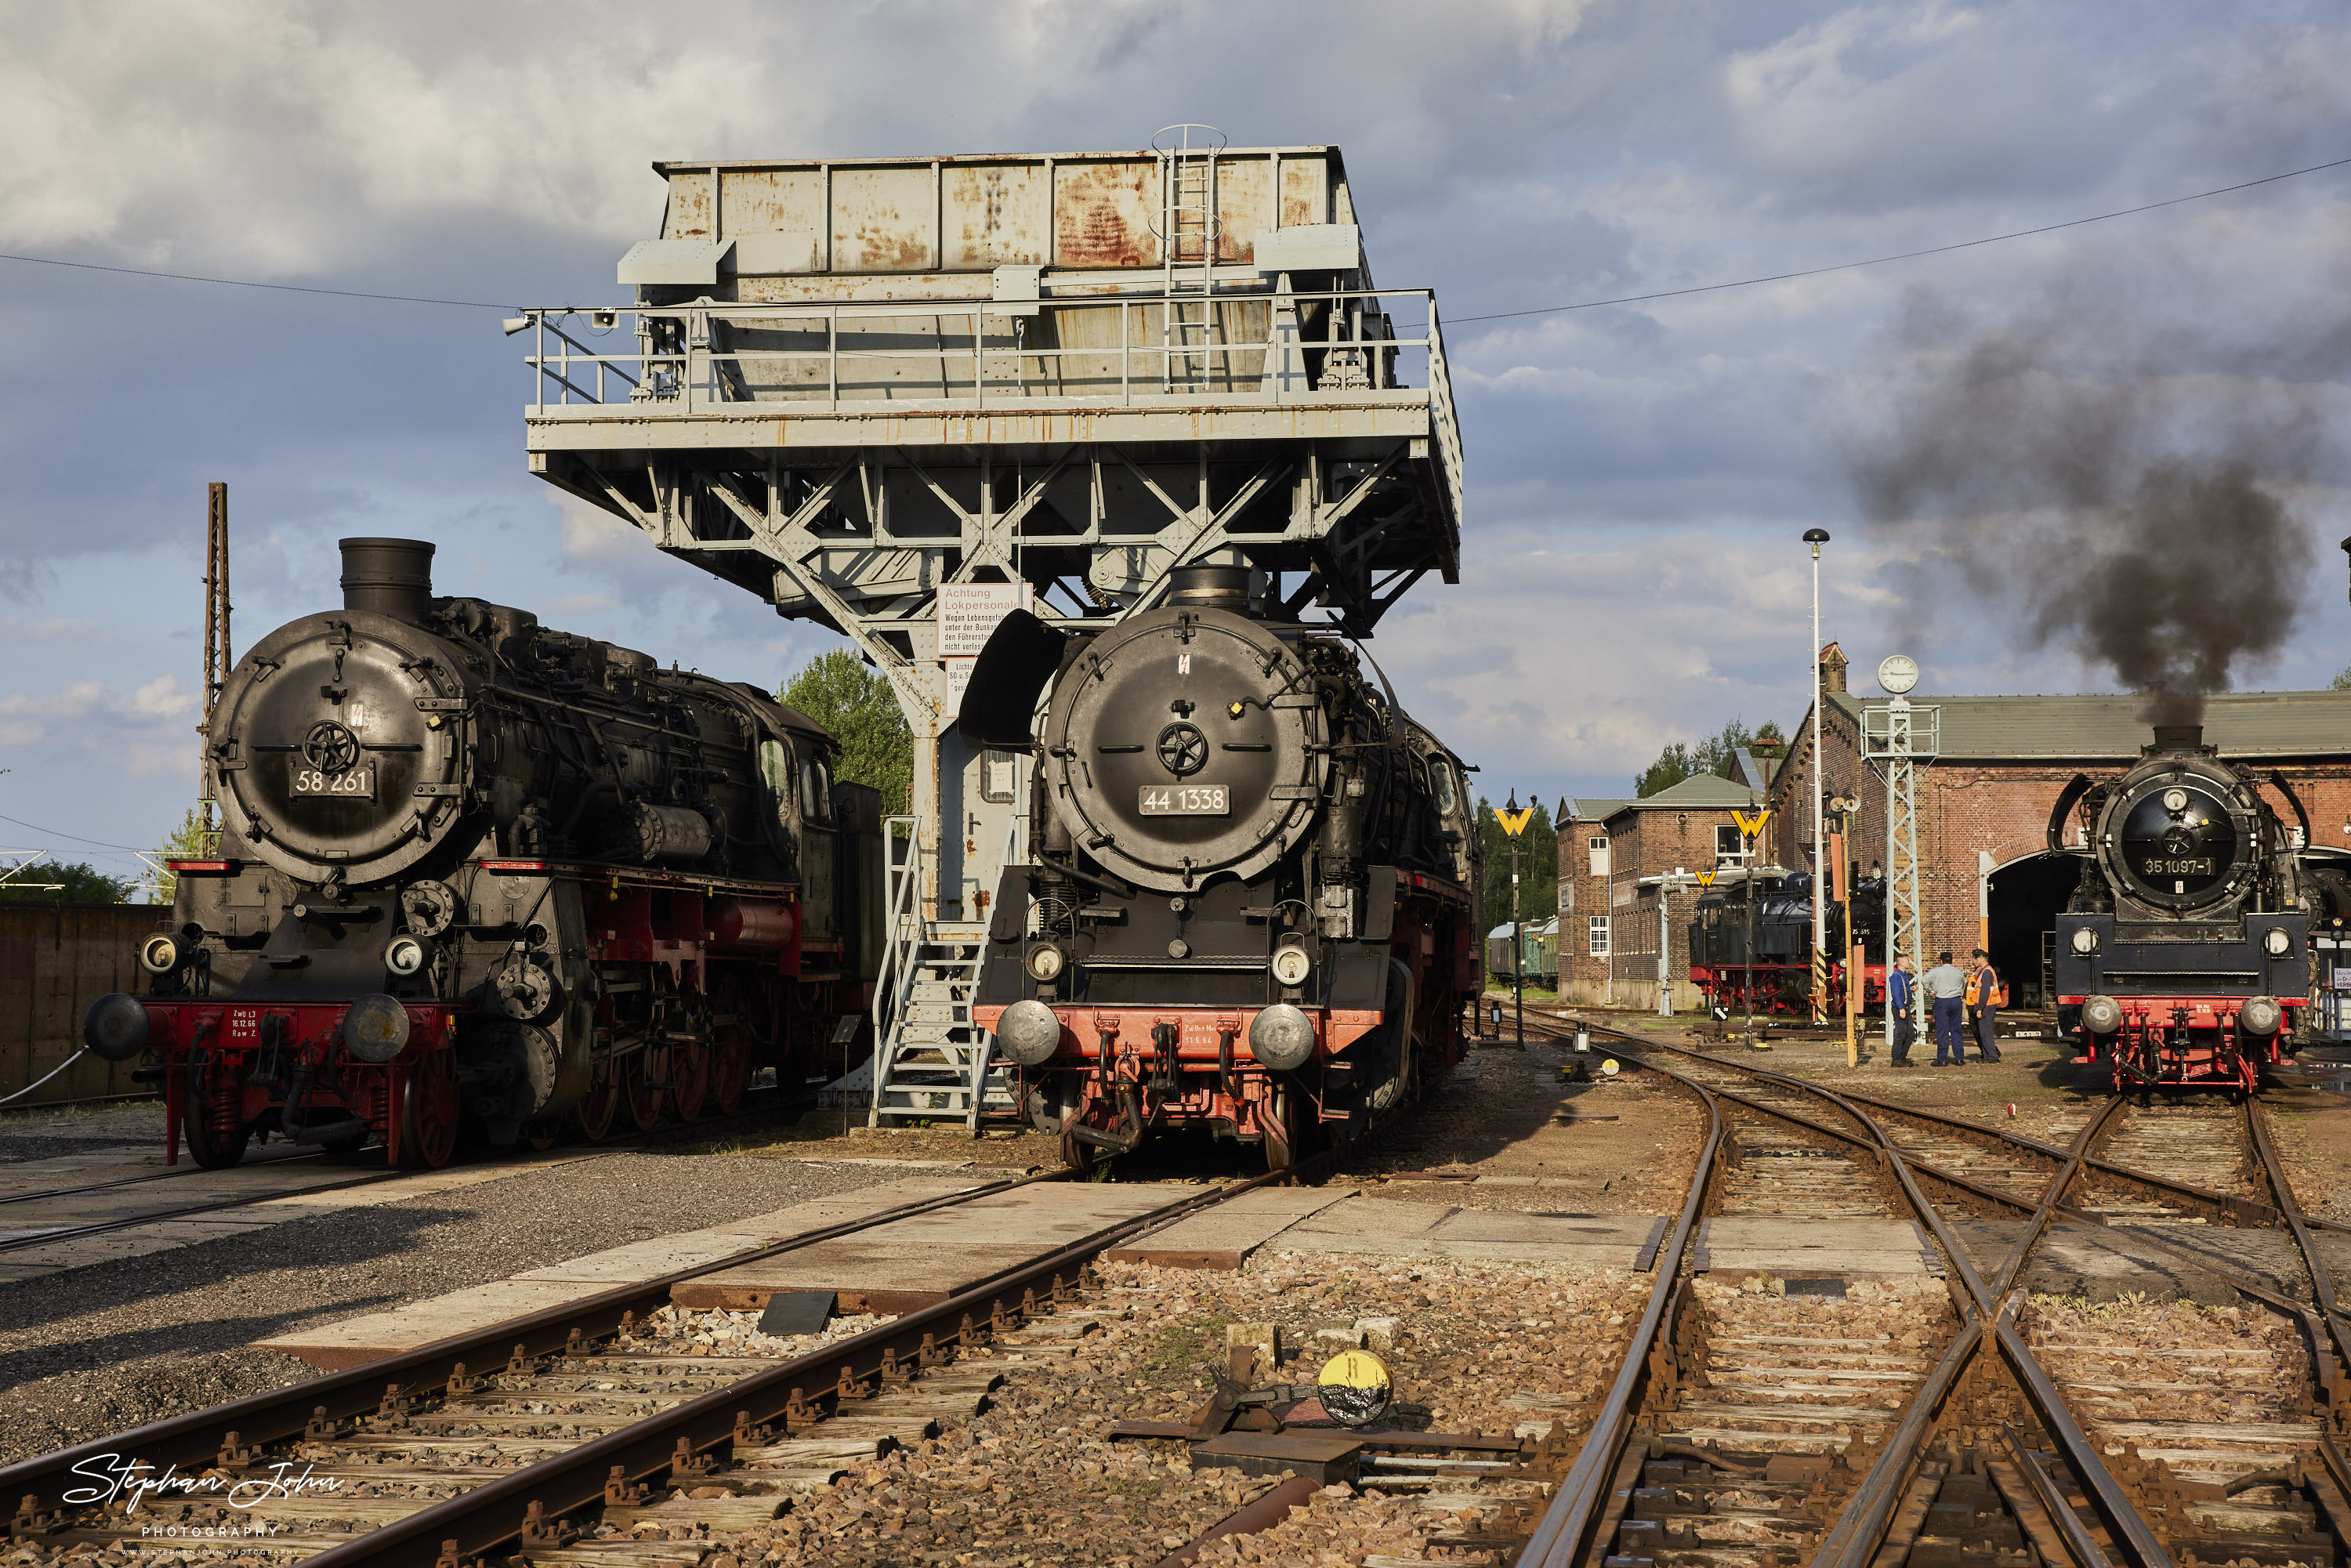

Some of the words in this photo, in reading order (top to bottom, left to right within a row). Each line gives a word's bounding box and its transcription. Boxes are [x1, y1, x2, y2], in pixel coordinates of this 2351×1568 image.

[946, 588, 991, 599] Achtung
[945, 614, 965, 622] Wegen
[295, 770, 323, 791] 58
[331, 771, 365, 791] 261
[1144, 790, 1171, 810] 44
[1179, 789, 1224, 809] 1338
[1493, 809, 1534, 837] W
[1730, 810, 1771, 838] W
[2146, 860, 2162, 873] 35
[2165, 860, 2212, 873] 1097-1
[1694, 871, 1718, 886] W
